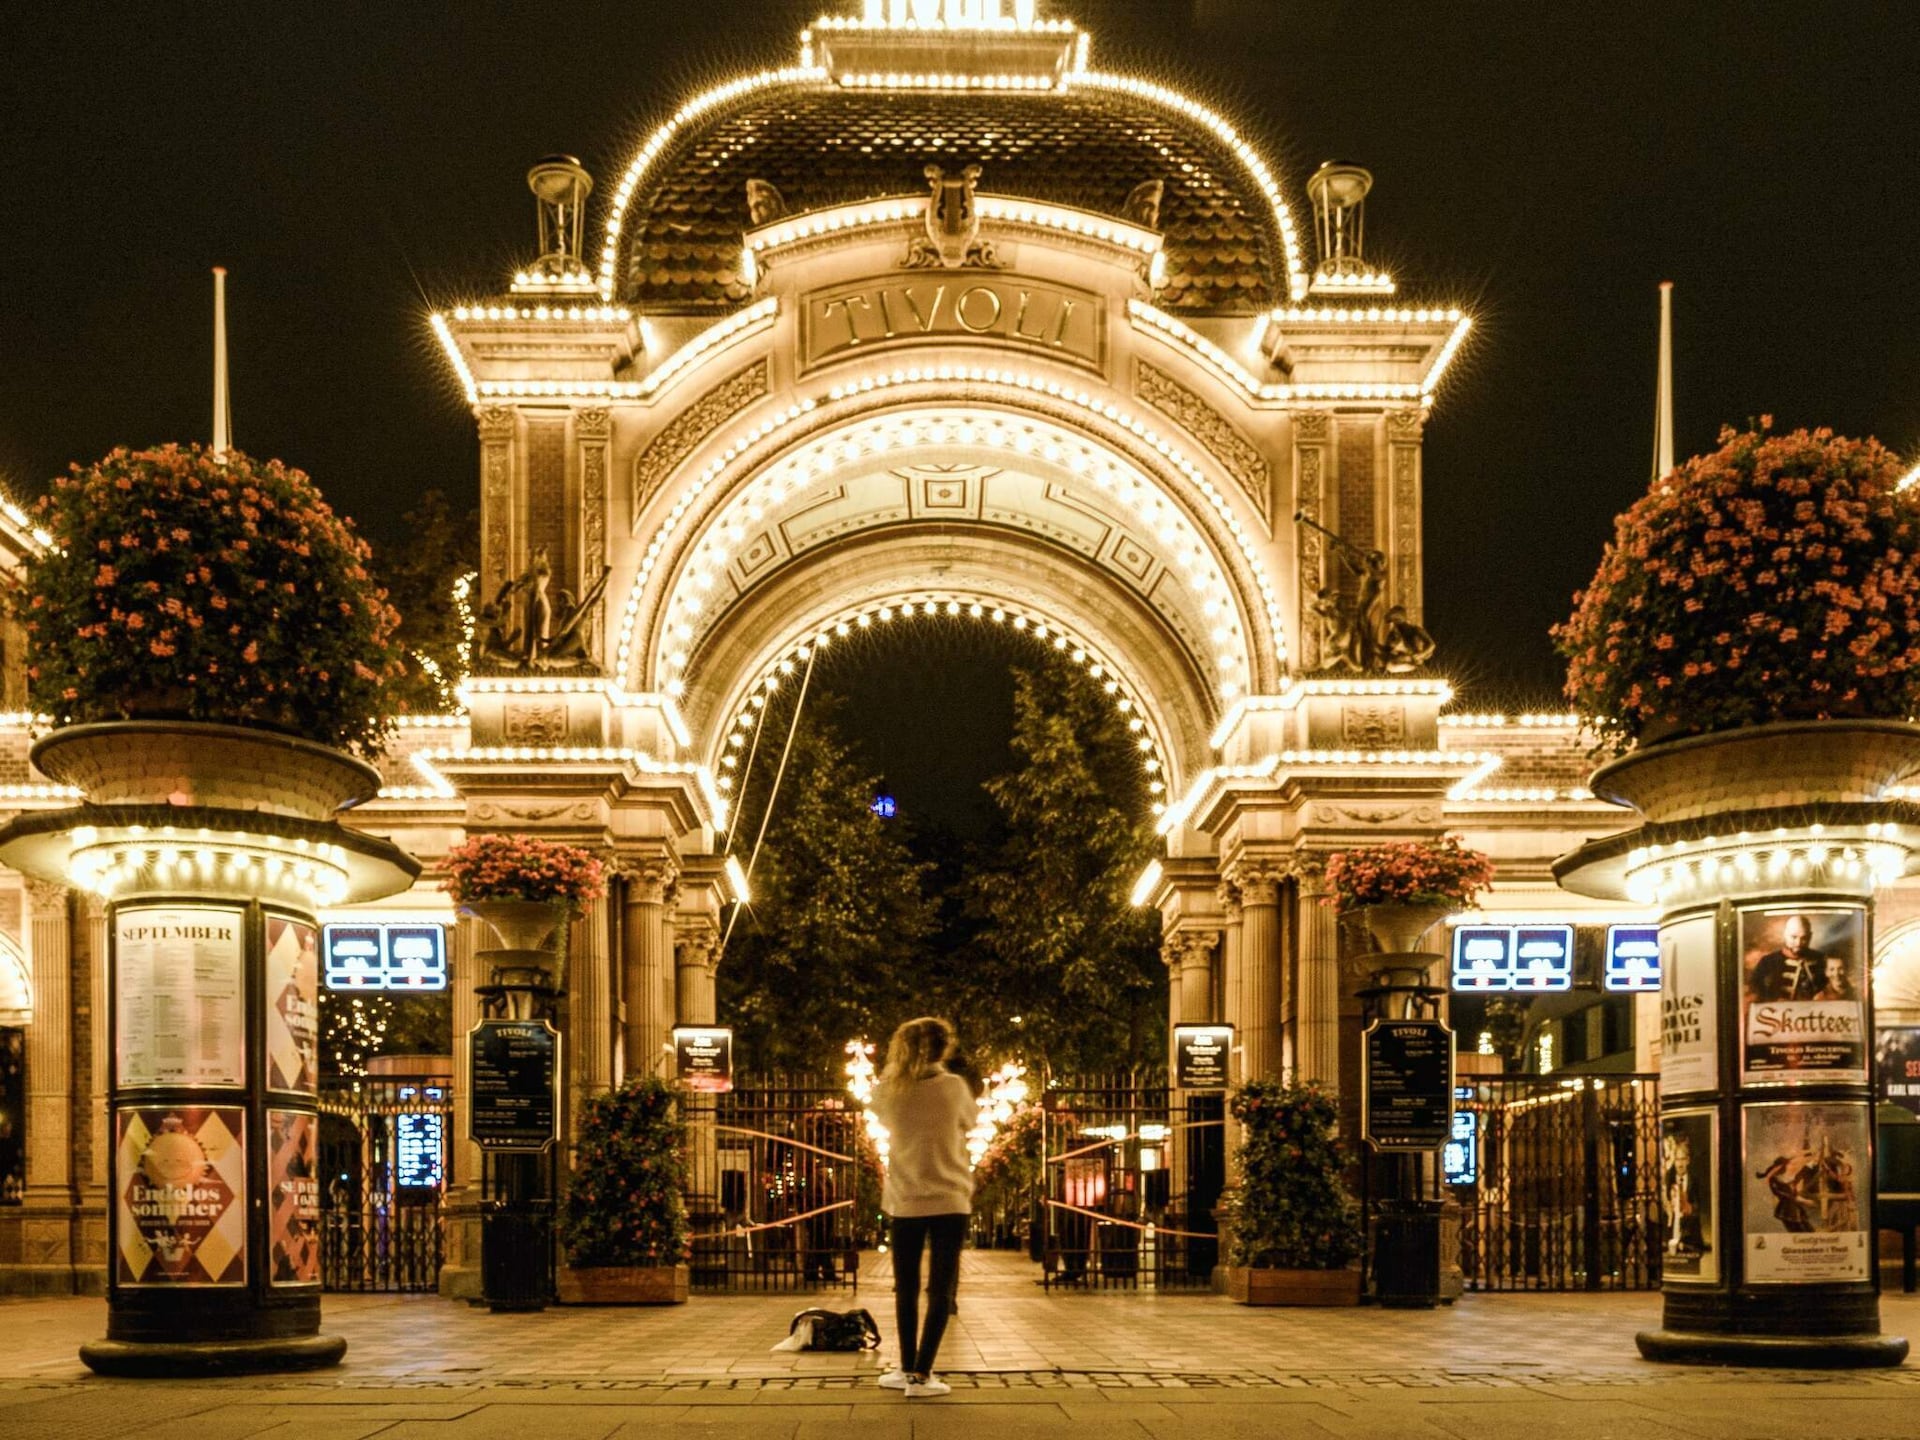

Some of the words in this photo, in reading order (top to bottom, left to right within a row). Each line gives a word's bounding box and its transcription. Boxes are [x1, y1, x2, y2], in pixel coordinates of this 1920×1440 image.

[825, 285, 1076, 345] TIVOLI
[122, 926, 231, 942] SEPTEMBER
[496, 1027, 532, 1038] TIVOLI
[1392, 1027, 1428, 1038] TIVOLI
